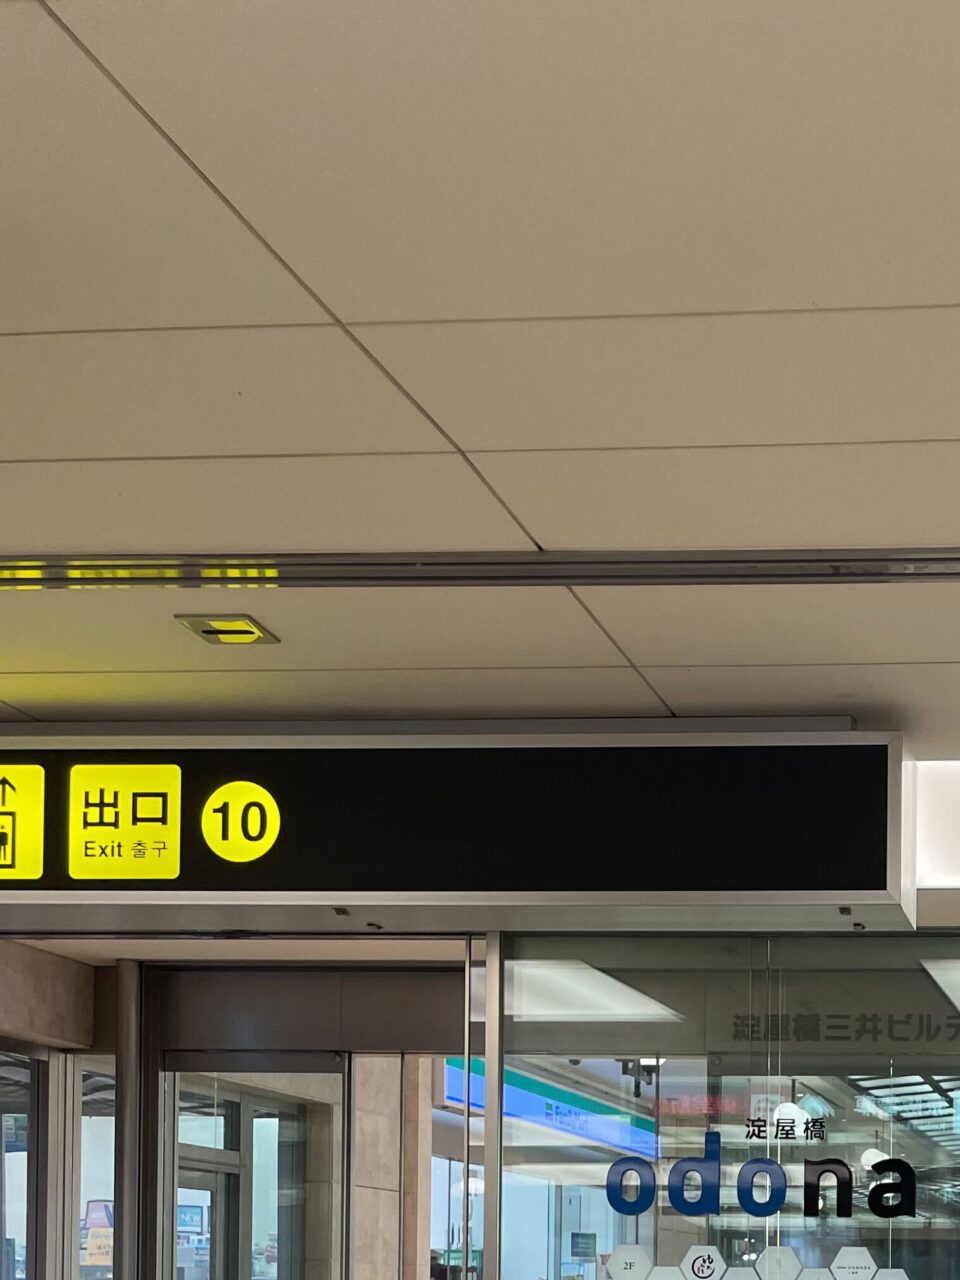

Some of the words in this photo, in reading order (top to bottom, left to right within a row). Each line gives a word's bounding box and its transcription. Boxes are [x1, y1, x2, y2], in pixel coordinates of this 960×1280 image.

[83, 788, 169, 830] 出口
[212, 801, 268, 842] 10
[84, 840, 123, 858] Exit
[131, 840, 168, 858] 출구
[744, 1117, 826, 1141] 淀屋橋
[605, 1131, 918, 1219] odona
[623, 1261, 636, 1271] 2F
